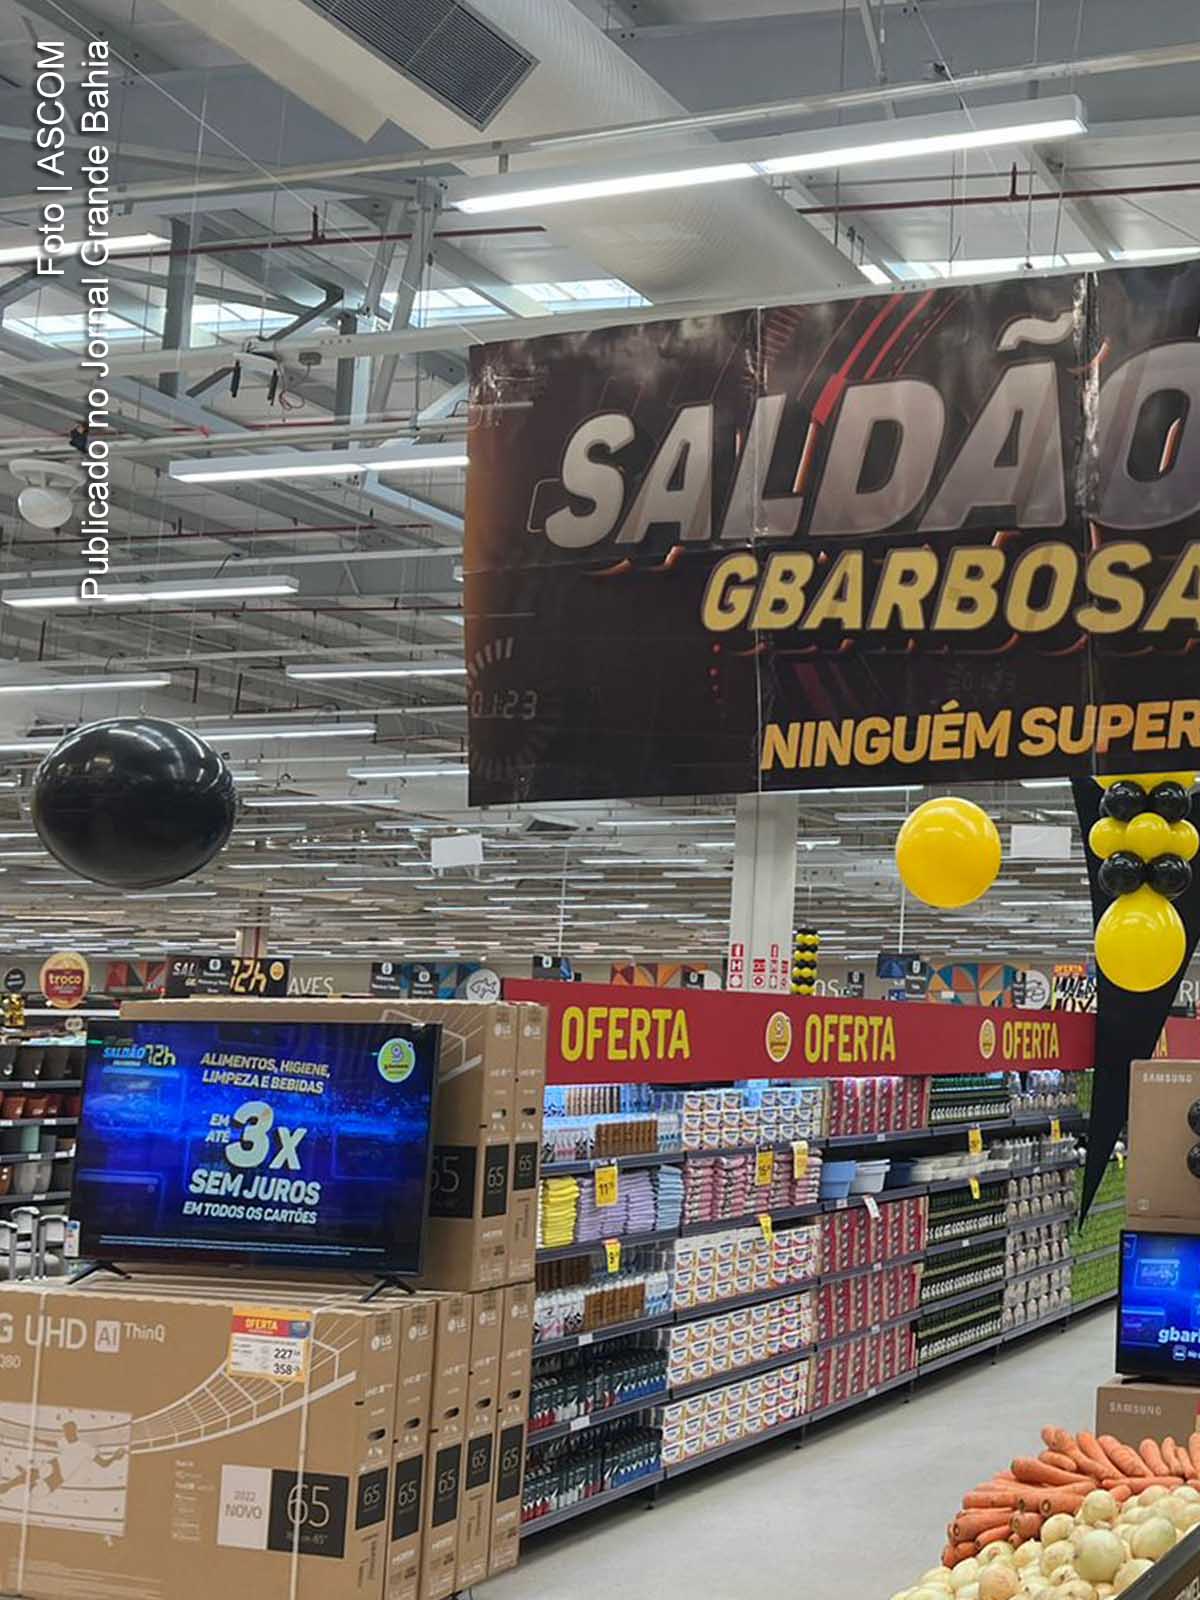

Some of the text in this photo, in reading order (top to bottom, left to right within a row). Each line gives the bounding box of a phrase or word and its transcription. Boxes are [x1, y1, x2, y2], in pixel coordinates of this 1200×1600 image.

[760, 699, 1011, 771] NINGUÉM
[286, 977, 334, 996] AVES
[560, 1006, 691, 1061] OFERTA
[805, 1013, 896, 1063] OFERTA
[1002, 1021, 1060, 1060] OFERTA
[200, 1053, 331, 1078] ALIMENTOS, HIGIENE,
[202, 1070, 259, 1089] LIMPEZA
[271, 1077, 324, 1094] BEBIDAS
[1143, 1073, 1193, 1084] SAMSUNG
[209, 1114, 230, 1127] EM
[189, 1169, 321, 1206] SEM JUROS
[182, 1201, 318, 1225] EM TODOS OS CARTÕES
[25, 1314, 87, 1350] UHD
[124, 1322, 166, 1343] ThinQ
[245, 1318, 278, 1330] OFERTA
[1109, 1402, 1162, 1416] SAMSUNG
[471, 1448, 487, 1466] 65
[502, 1447, 519, 1472] 65
[363, 1483, 381, 1506] 65
[399, 1480, 417, 1507] 65
[439, 1469, 457, 1495] 65
[224, 1504, 263, 1520] NOVO
[287, 1484, 331, 1528] 65
